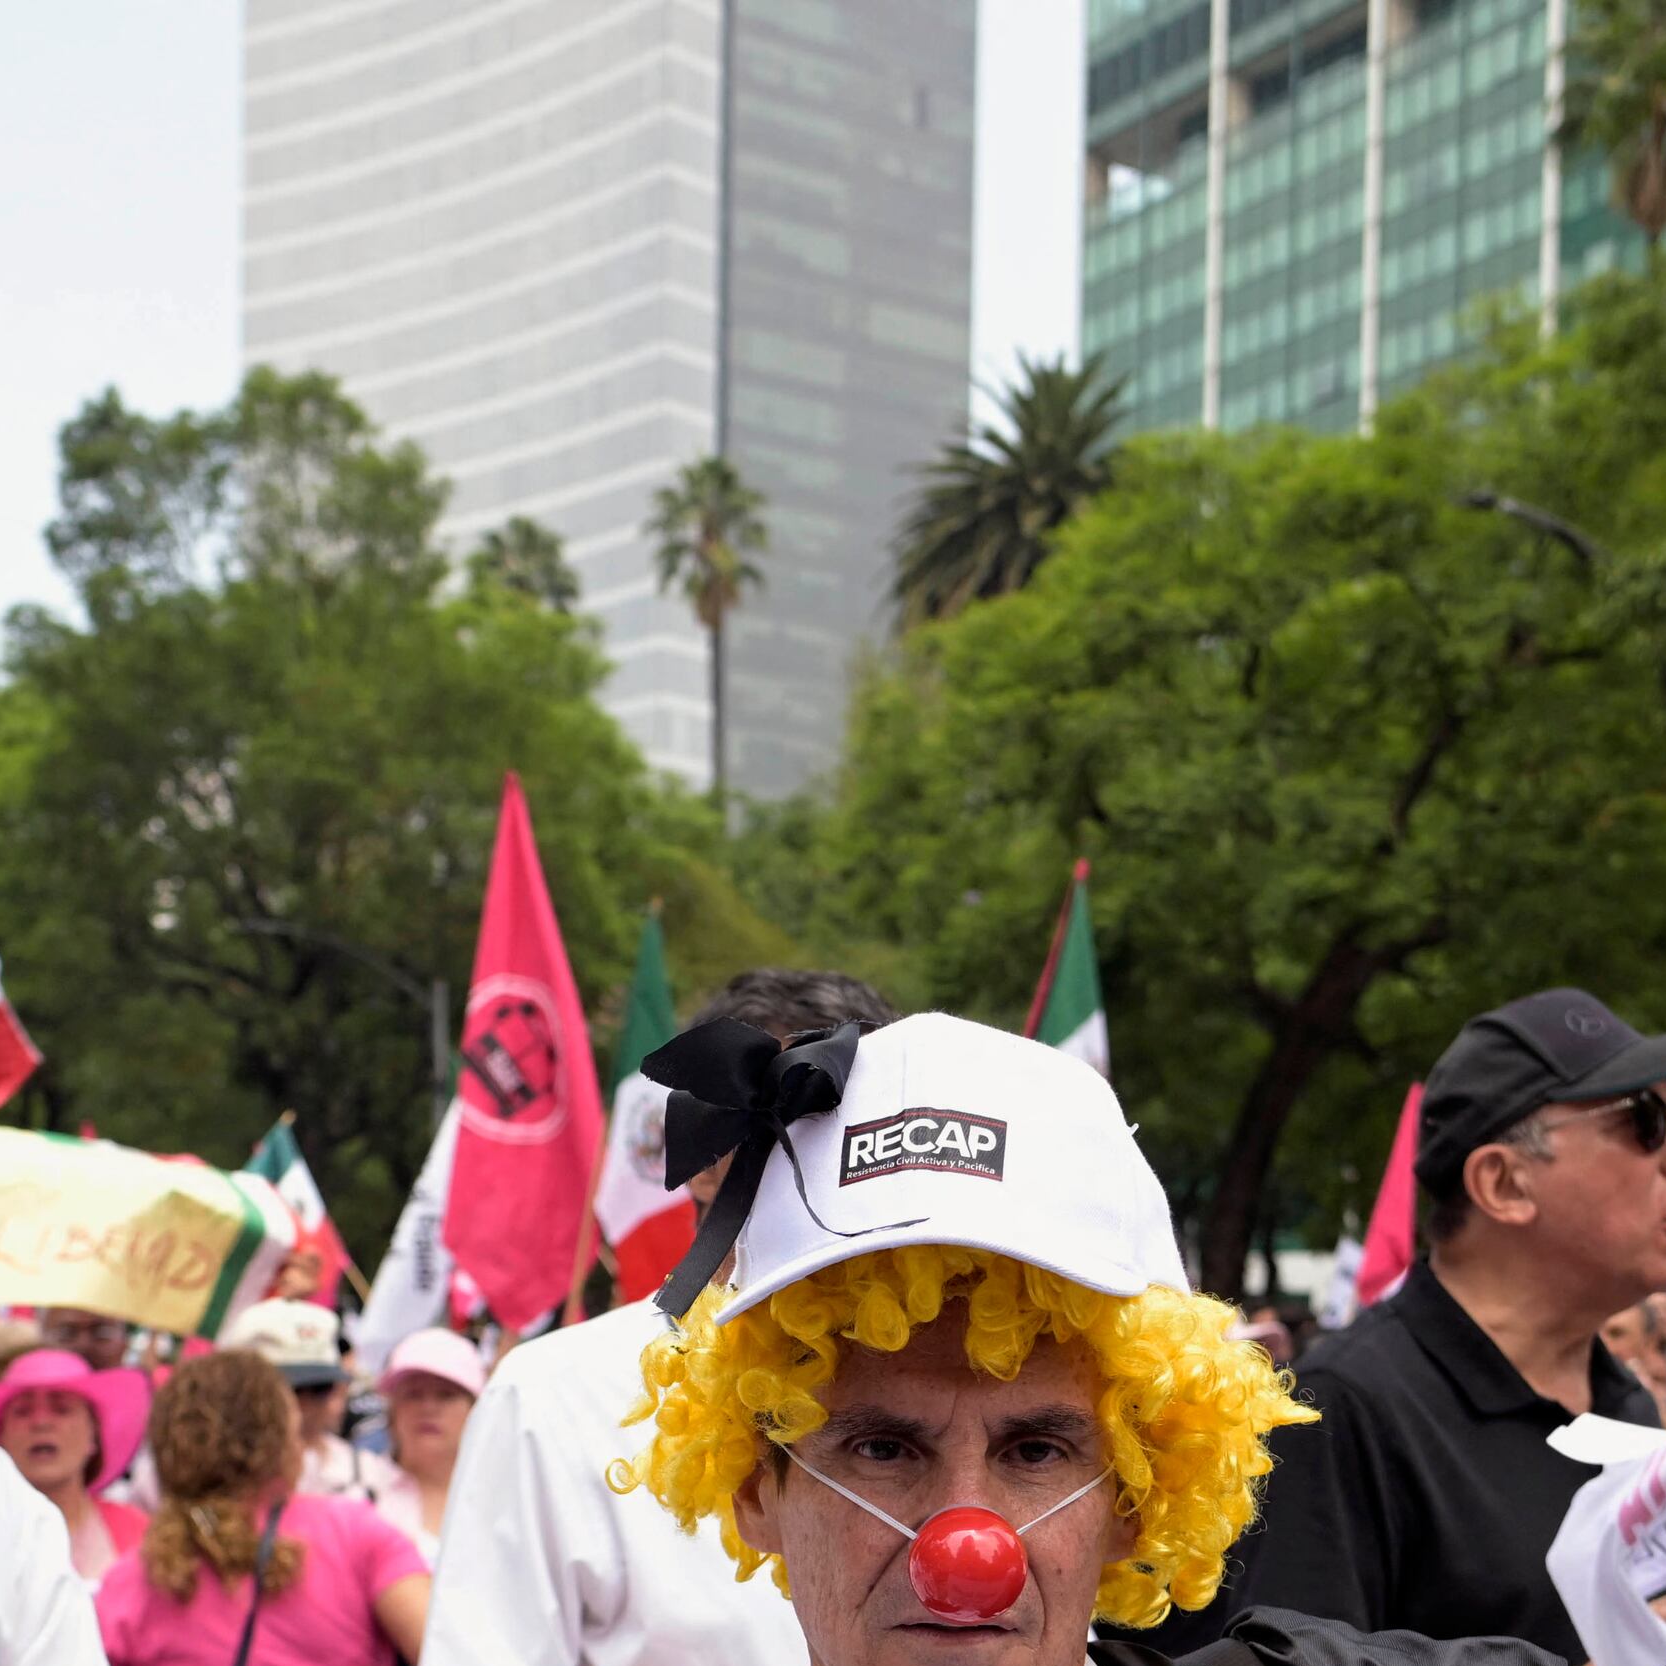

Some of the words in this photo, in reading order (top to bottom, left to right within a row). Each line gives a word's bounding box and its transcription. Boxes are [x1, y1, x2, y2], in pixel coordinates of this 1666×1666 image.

[848, 1118, 997, 1168] RECAP
[846, 1161, 895, 1180] Resistencia
[896, 1157, 916, 1166] Civil
[918, 1157, 947, 1166] Activa
[949, 1160, 955, 1168] y
